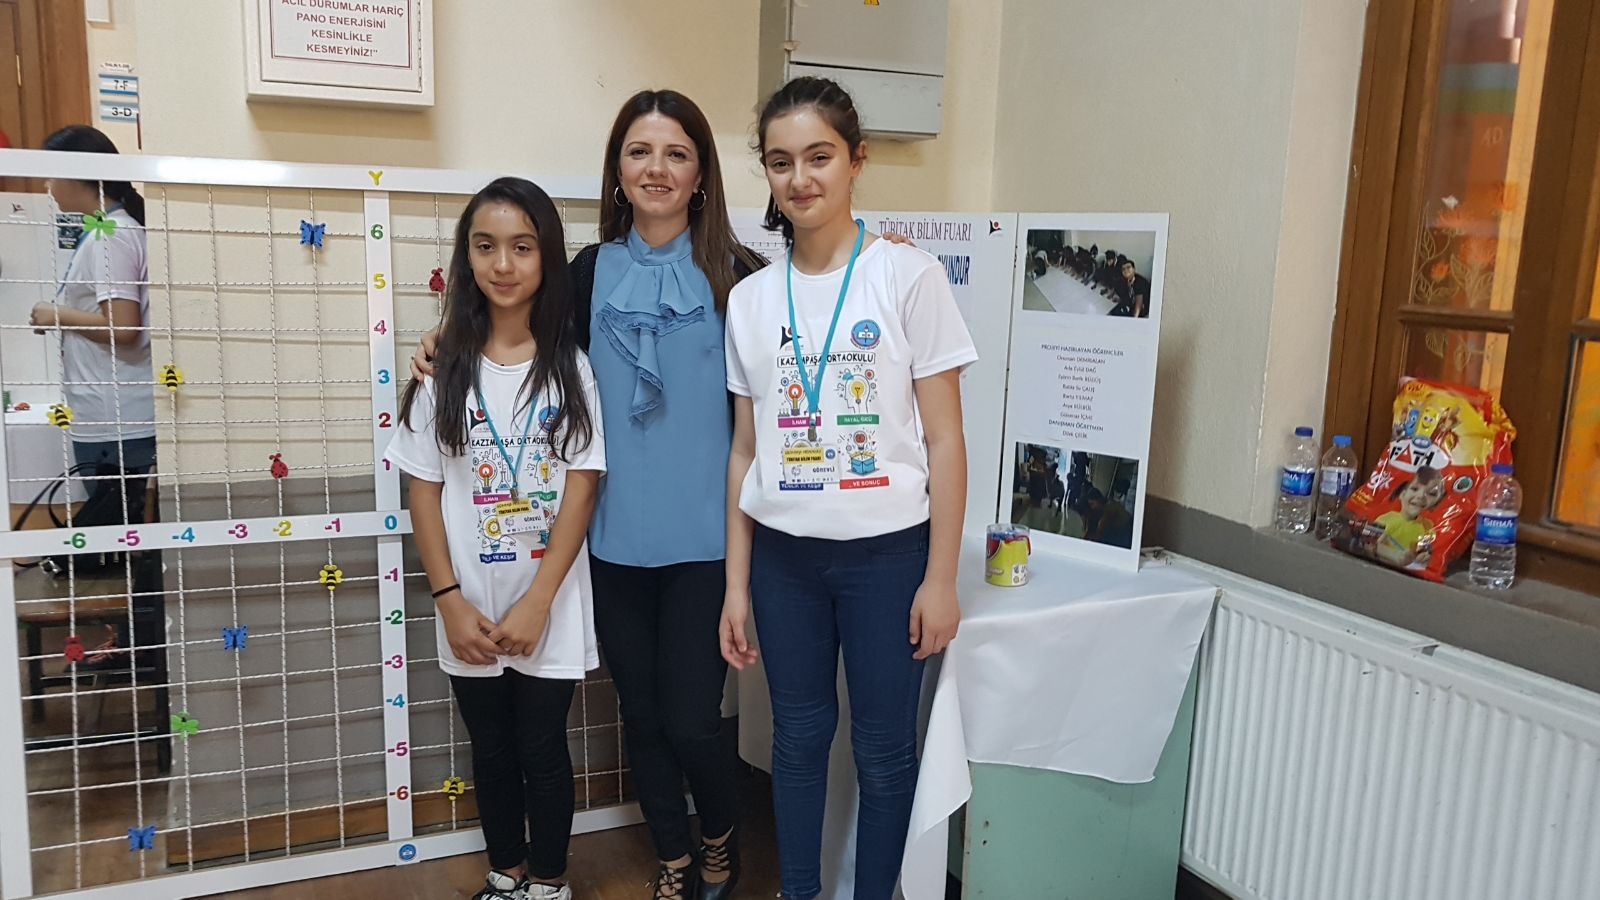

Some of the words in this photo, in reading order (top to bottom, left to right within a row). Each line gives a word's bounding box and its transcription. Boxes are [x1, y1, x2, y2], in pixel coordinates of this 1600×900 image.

[309, 0, 369, 12] DURUMLAR
[372, 5, 404, 17] HARİÇ
[296, 12, 326, 23] PANO
[329, 15, 386, 29] ENERJİSİNİ
[311, 29, 373, 42] KESİNLİKLE
[111, 106, 133, 117] 3-D
[369, 170, 384, 186] Y
[370, 223, 384, 240] 6
[879, 217, 915, 239] TÜBİTAK
[917, 217, 942, 240] BİLİM
[944, 222, 972, 241] FUARI
[938, 254, 970, 285] YUNDUR
[373, 272, 386, 289] 5
[373, 319, 387, 335] 4
[826, 353, 873, 362] ORTAOKULU
[377, 369, 390, 384] 3
[378, 412, 392, 428] 2
[382, 458, 391, 471] 1
[63, 532, 87, 550] -6
[117, 529, 140, 547] -5
[172, 527, 195, 543] -4
[228, 523, 249, 539] -3
[272, 520, 292, 536] -2
[324, 518, 341, 533] -1
[384, 515, 398, 530] 0
[384, 568, 399, 582] -1
[385, 609, 403, 625] -2
[384, 655, 404, 669] -3
[386, 694, 405, 708] -4
[387, 742, 408, 757] -5
[389, 785, 409, 800] -6
